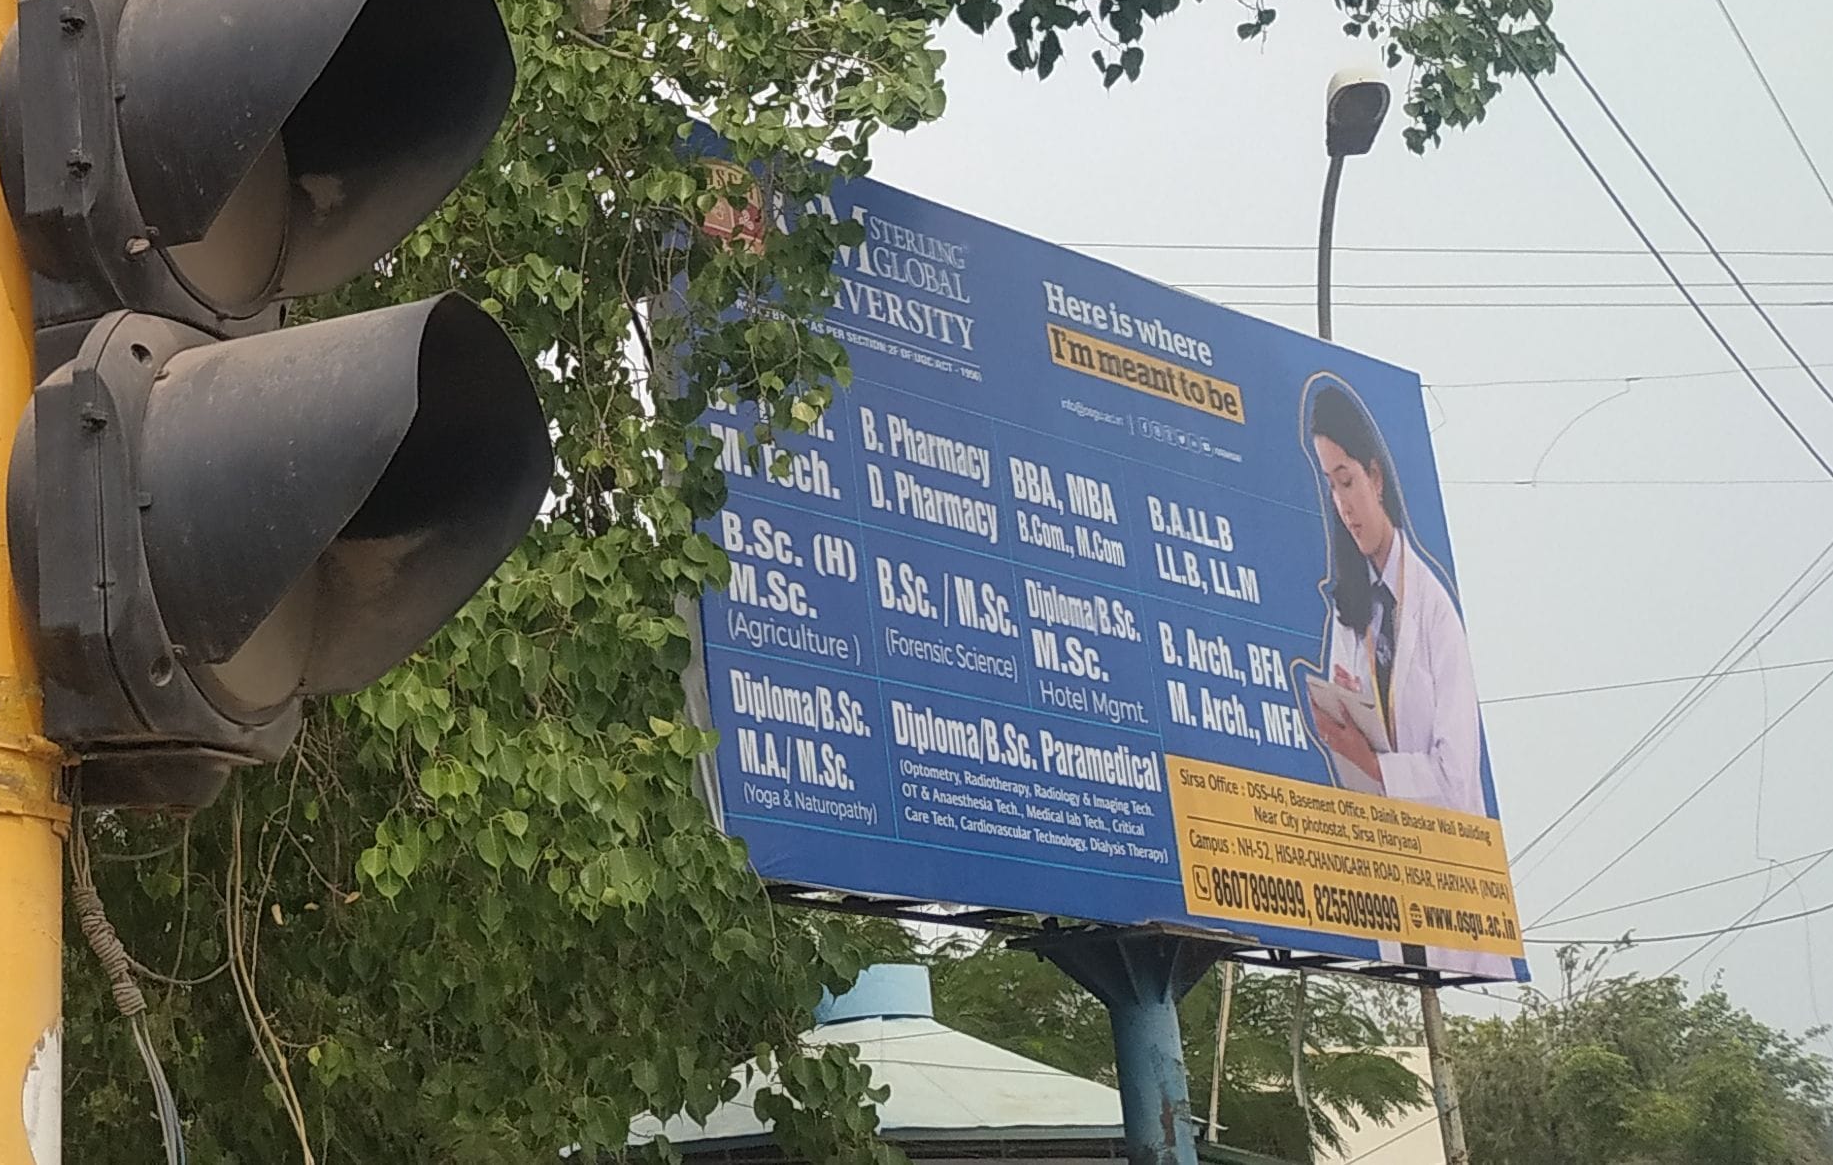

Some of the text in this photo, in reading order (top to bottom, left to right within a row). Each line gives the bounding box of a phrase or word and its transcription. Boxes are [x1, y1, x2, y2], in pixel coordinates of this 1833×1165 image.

[870, 216, 966, 269] STERLING
[873, 247, 971, 304] GLOBAL
[826, 327, 845, 340] PER
[1042, 281, 1213, 366] Here is where
[1050, 327, 1238, 416] I'm meant to be
[859, 406, 885, 453] B.
[887, 413, 990, 488] Pharmacy
[867, 464, 998, 544] D. Pharmacy
[1009, 456, 1118, 525] BBA, MBA
[721, 509, 857, 582] B.Sc. (H)
[1017, 510, 1126, 568] B.Com., M.Com
[729, 561, 818, 619] M.Sc.
[876, 557, 938, 619] B.Sc.
[954, 575, 1019, 638] M.Sc.
[1155, 543, 1261, 604] LL.B, LL.M
[1025, 578, 1142, 642] Diploma/B.Sc.
[886, 627, 1018, 683] (Forensic Science)
[1031, 628, 1110, 682] M.Sc.
[1158, 621, 1289, 692] B. Arch., BFA
[729, 669, 871, 737] Diploma/B.Sc.
[1039, 680, 1149, 724] Hotel Mgmt.
[1167, 680, 1309, 751] M. Arch., MFA
[796, 738, 855, 791] M.Sc.
[891, 700, 1162, 793] Diploma/B.Sc. Paramedical
[743, 782, 878, 825] (Yoga & Naturopathy)
[899, 759, 1155, 817] (Optometry, Radiotherapy, Radiology & Imaging Tech.
[902, 782, 918, 799] OT
[921, 786, 930, 801] &
[933, 788, 993, 812] Anaesthesia
[1026, 804, 1064, 824] Medical
[1112, 819, 1145, 837] Critical
[1180, 768, 1205, 789] Sirsa
[1208, 774, 1239, 795] Office
[1247, 781, 1288, 807] DSS-46,
[1289, 789, 1336, 815] Basement
[1370, 806, 1399, 823] Dainik
[1400, 811, 1436, 831] Bhaskar
[1458, 822, 1492, 847] Building
[904, 806, 1168, 864] Care Tech, Cardiovascular Technology, Dialysis Therapy)
[1253, 806, 1422, 854] Near City photostat, Sirsa (Haryana)
[1189, 828, 1229, 857] Campus
[1237, 837, 1274, 865] NH-52,
[1275, 843, 1371, 879] HISAR-CHANDIGARH
[1373, 861, 1405, 885] ROAD,
[1405, 866, 1436, 891] HISAR,
[1436, 872, 1478, 897] HARYANA
[1479, 879, 1511, 904] (INDIA)
[1211, 867, 1517, 941] 8607899999, 8255099999 www.osgu.ac.in
